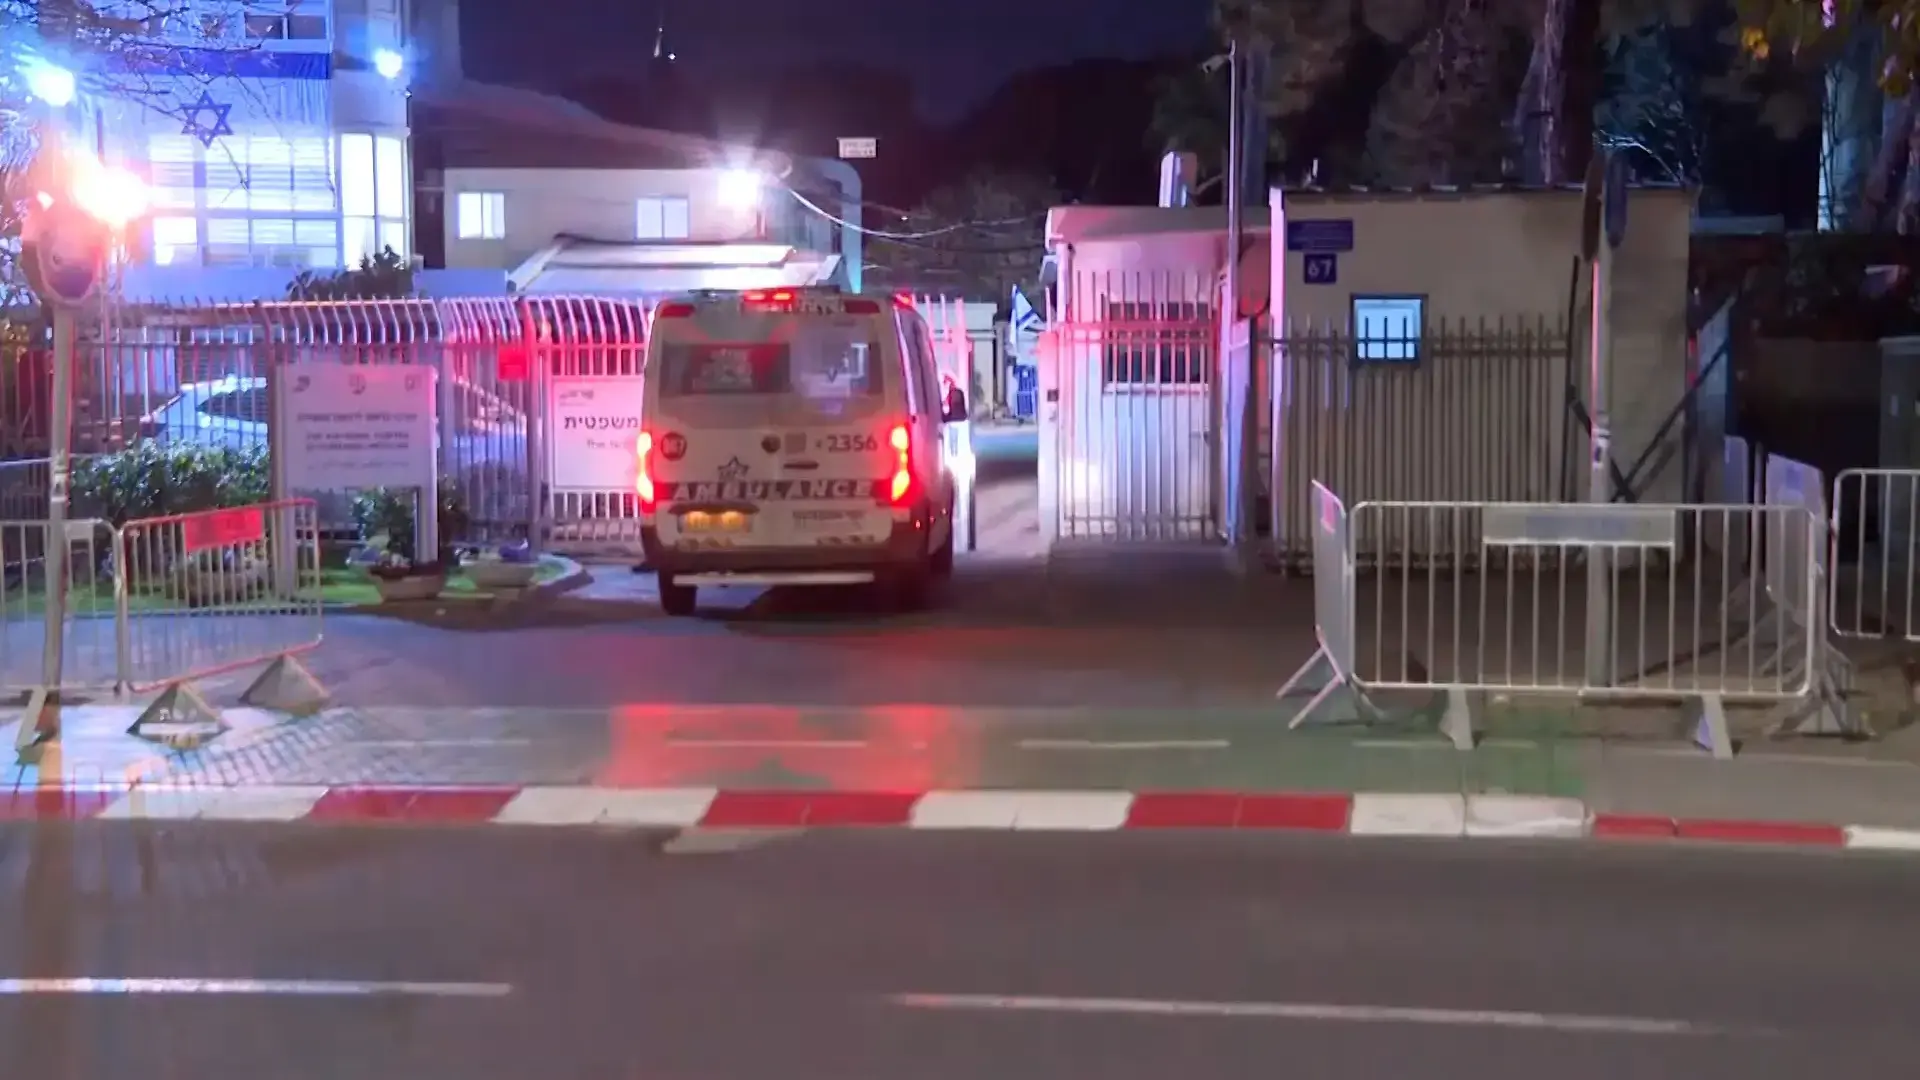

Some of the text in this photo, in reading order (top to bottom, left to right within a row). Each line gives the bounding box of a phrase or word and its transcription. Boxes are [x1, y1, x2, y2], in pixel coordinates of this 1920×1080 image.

[1307, 259, 1333, 280] 67
[564, 415, 639, 430] משפטית
[673, 479, 873, 501] AMBULANCE
